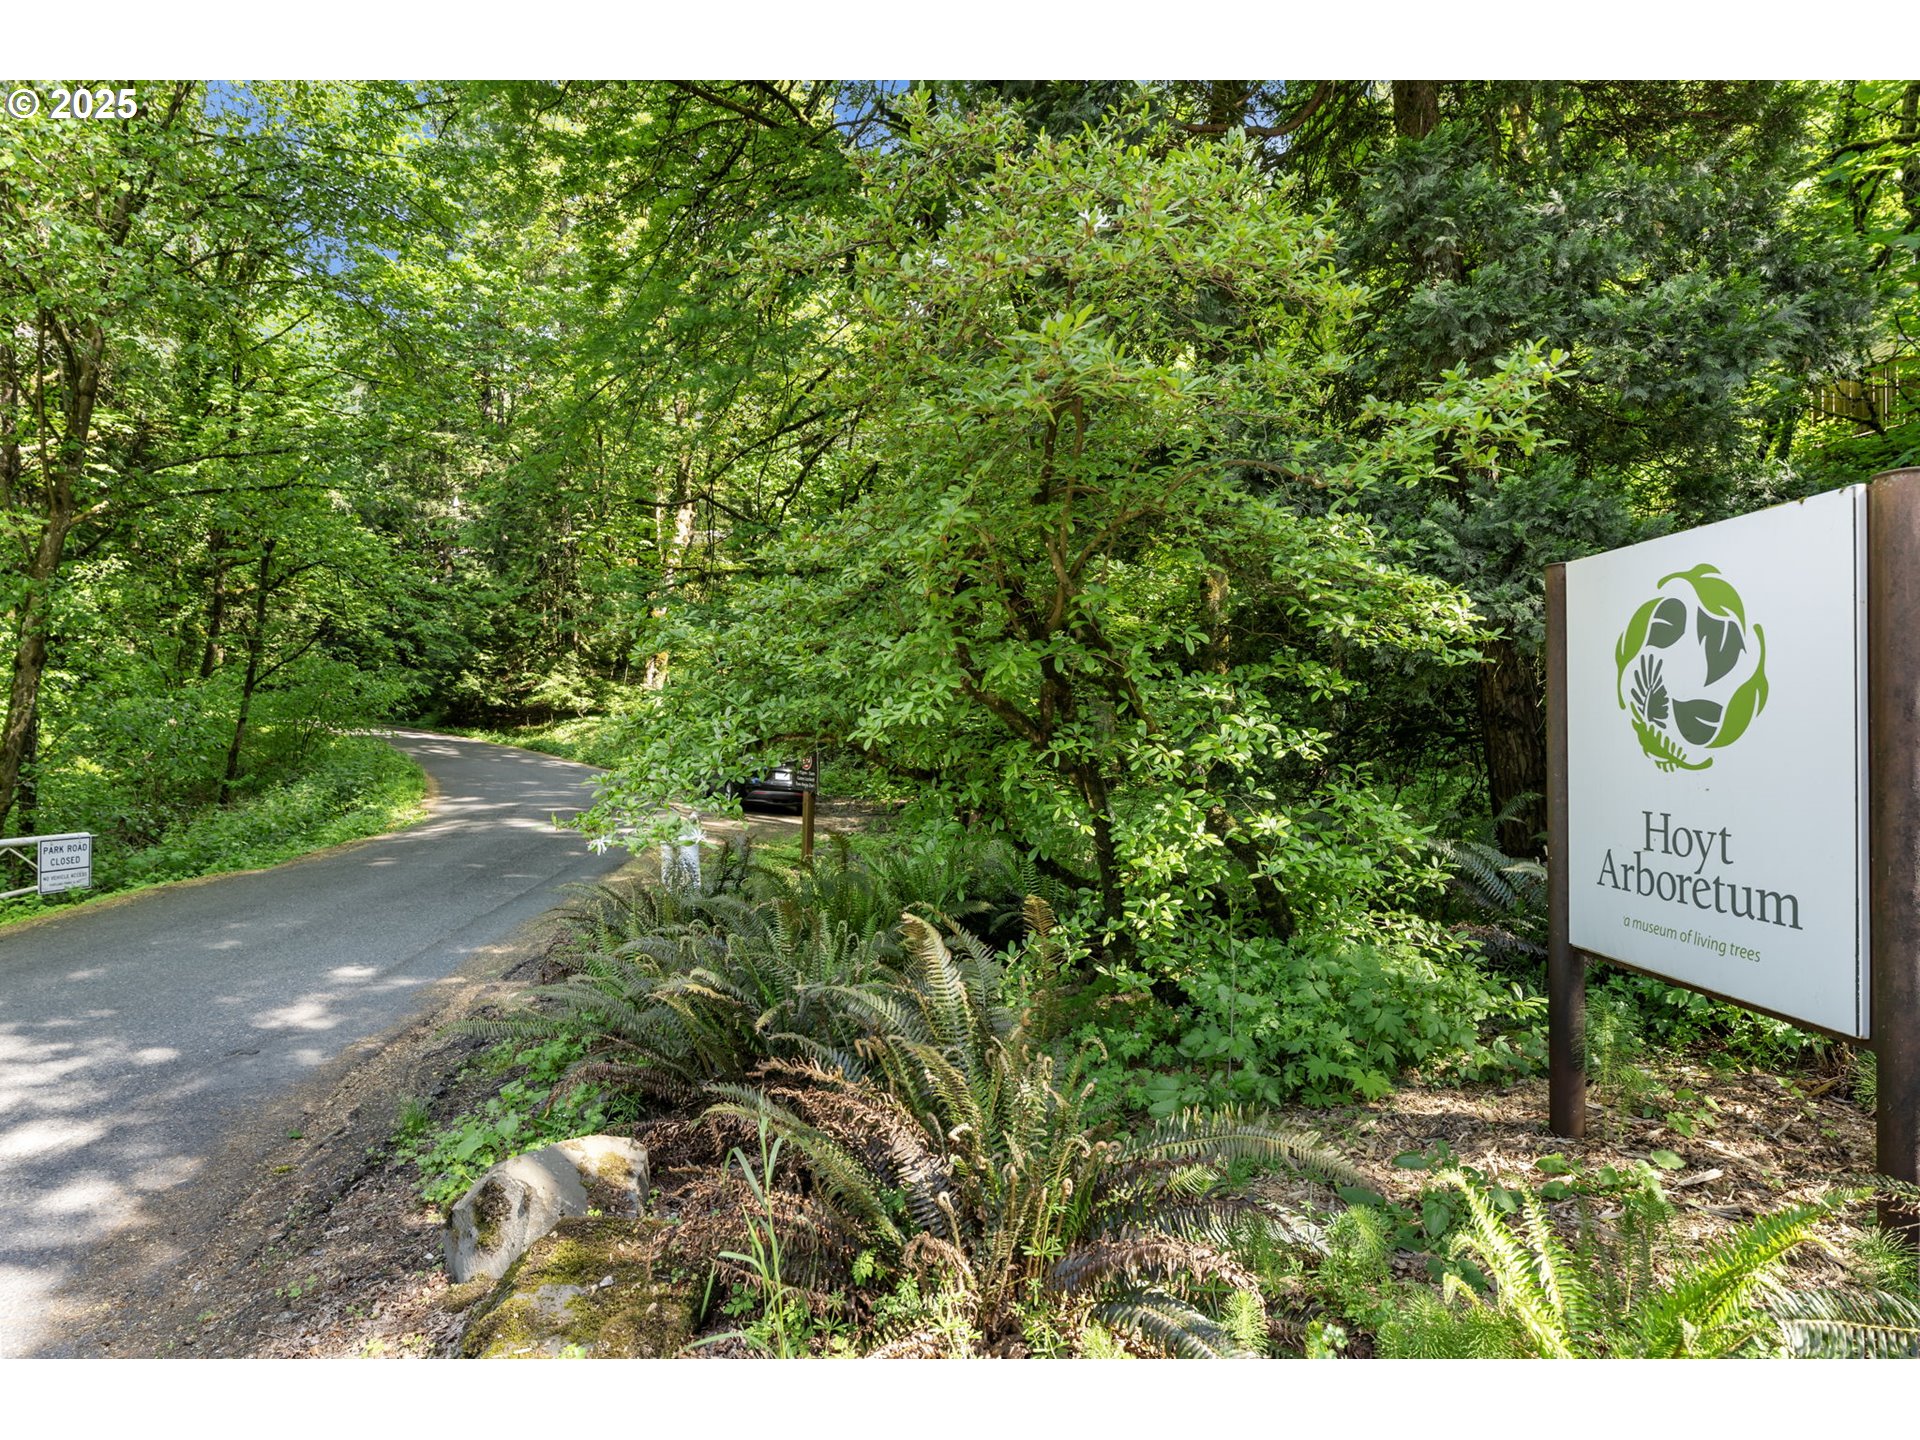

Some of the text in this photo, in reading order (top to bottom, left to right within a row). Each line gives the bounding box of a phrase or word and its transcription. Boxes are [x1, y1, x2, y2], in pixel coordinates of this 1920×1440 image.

[43, 843, 88, 854] PARK ROAD
[50, 856, 81, 866] CLOSED
[1642, 810, 1734, 875] Hoyt
[1596, 848, 1803, 931] Arboretum
[1623, 915, 1761, 963] a museum of living trees
